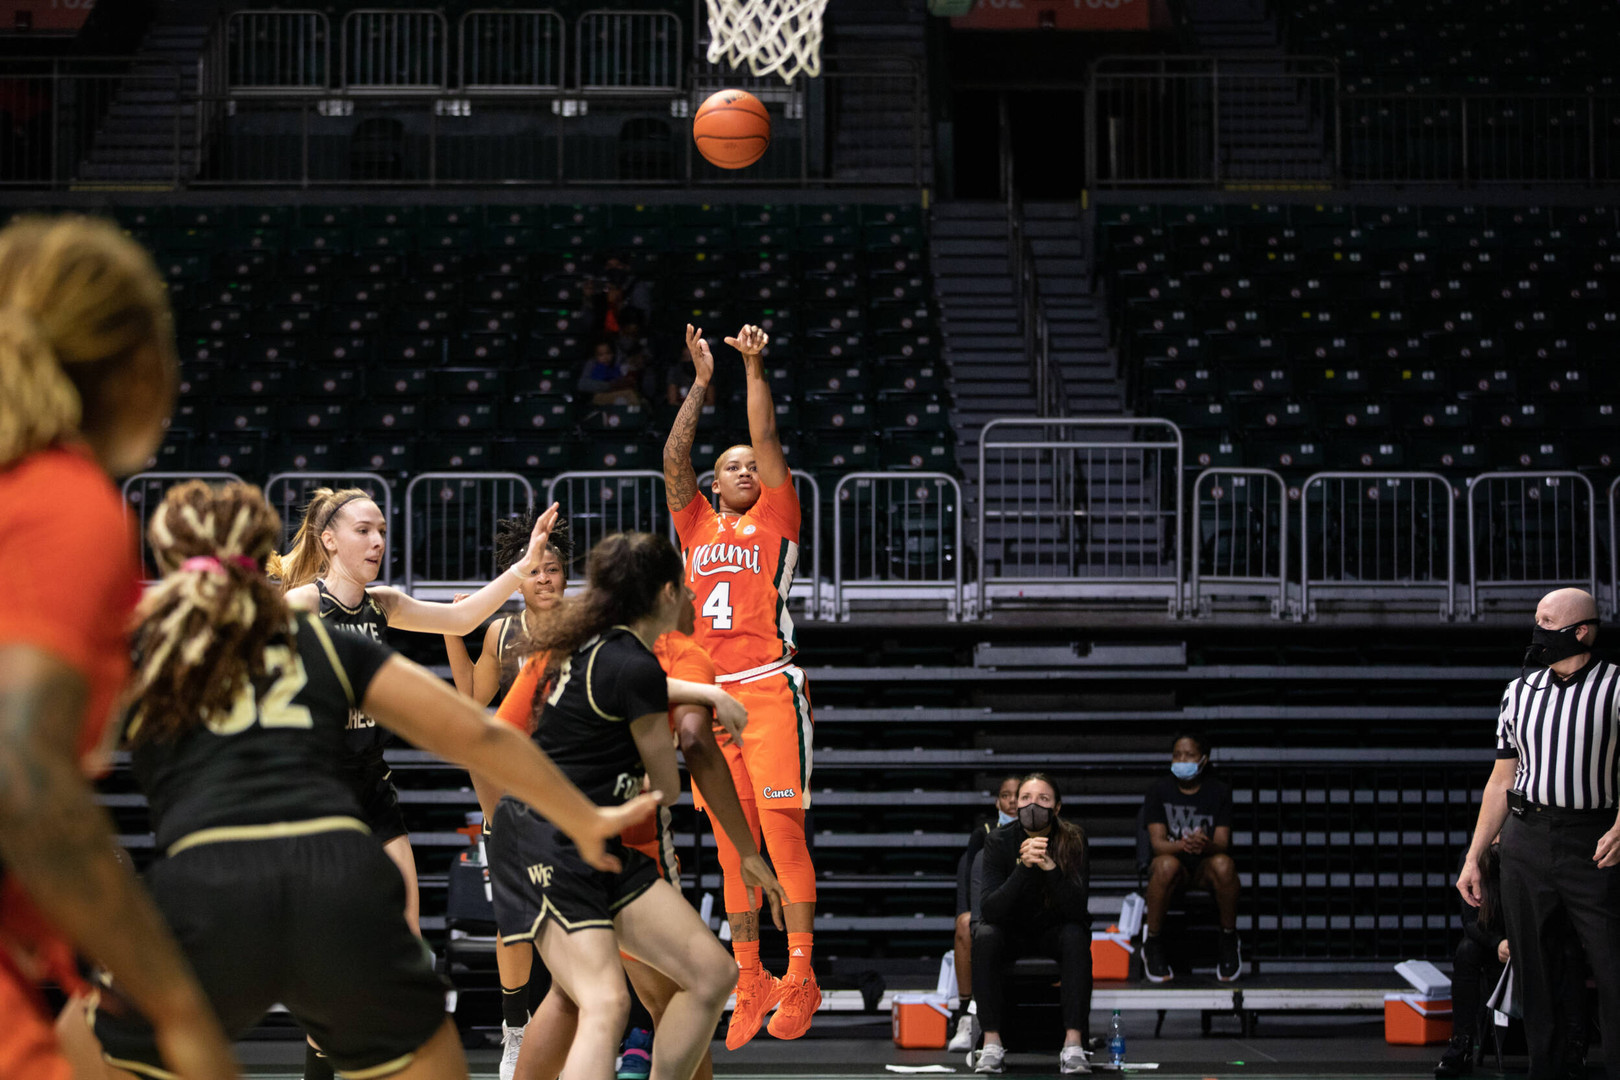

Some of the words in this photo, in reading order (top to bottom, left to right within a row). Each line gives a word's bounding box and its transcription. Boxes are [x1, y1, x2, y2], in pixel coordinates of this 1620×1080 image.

[691, 542, 761, 582] Miami
[702, 581, 732, 630] 4
[763, 786, 795, 799] Canes
[527, 863, 554, 888] WF
